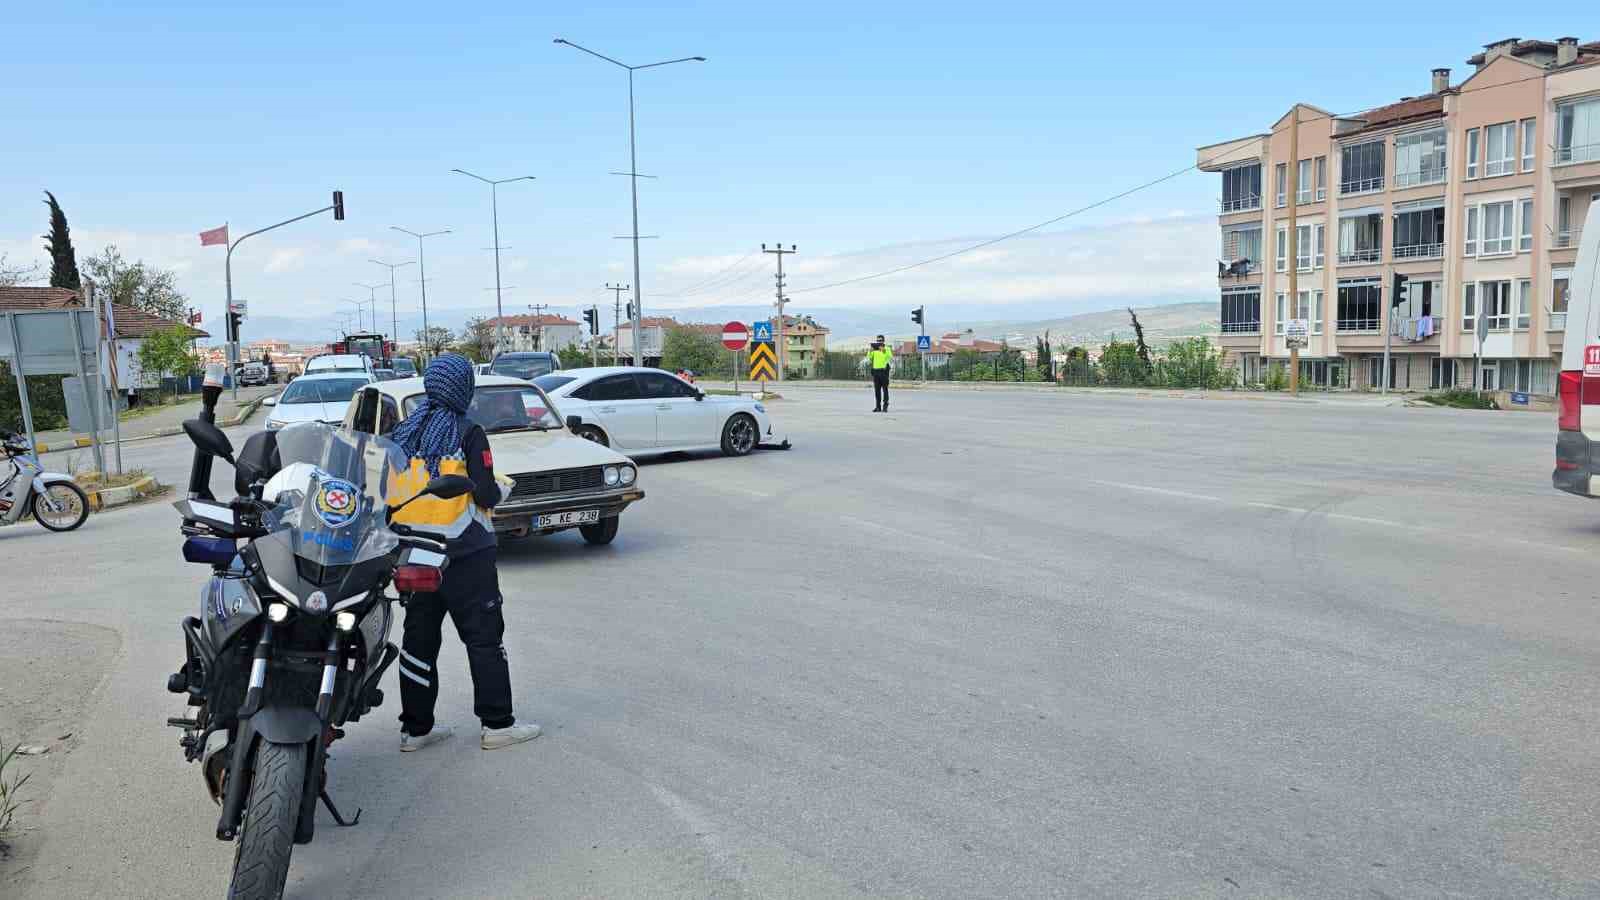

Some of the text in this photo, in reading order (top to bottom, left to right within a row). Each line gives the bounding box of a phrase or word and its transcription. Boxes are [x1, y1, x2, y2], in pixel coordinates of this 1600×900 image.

[539, 510, 597, 526] 05 KE 238
